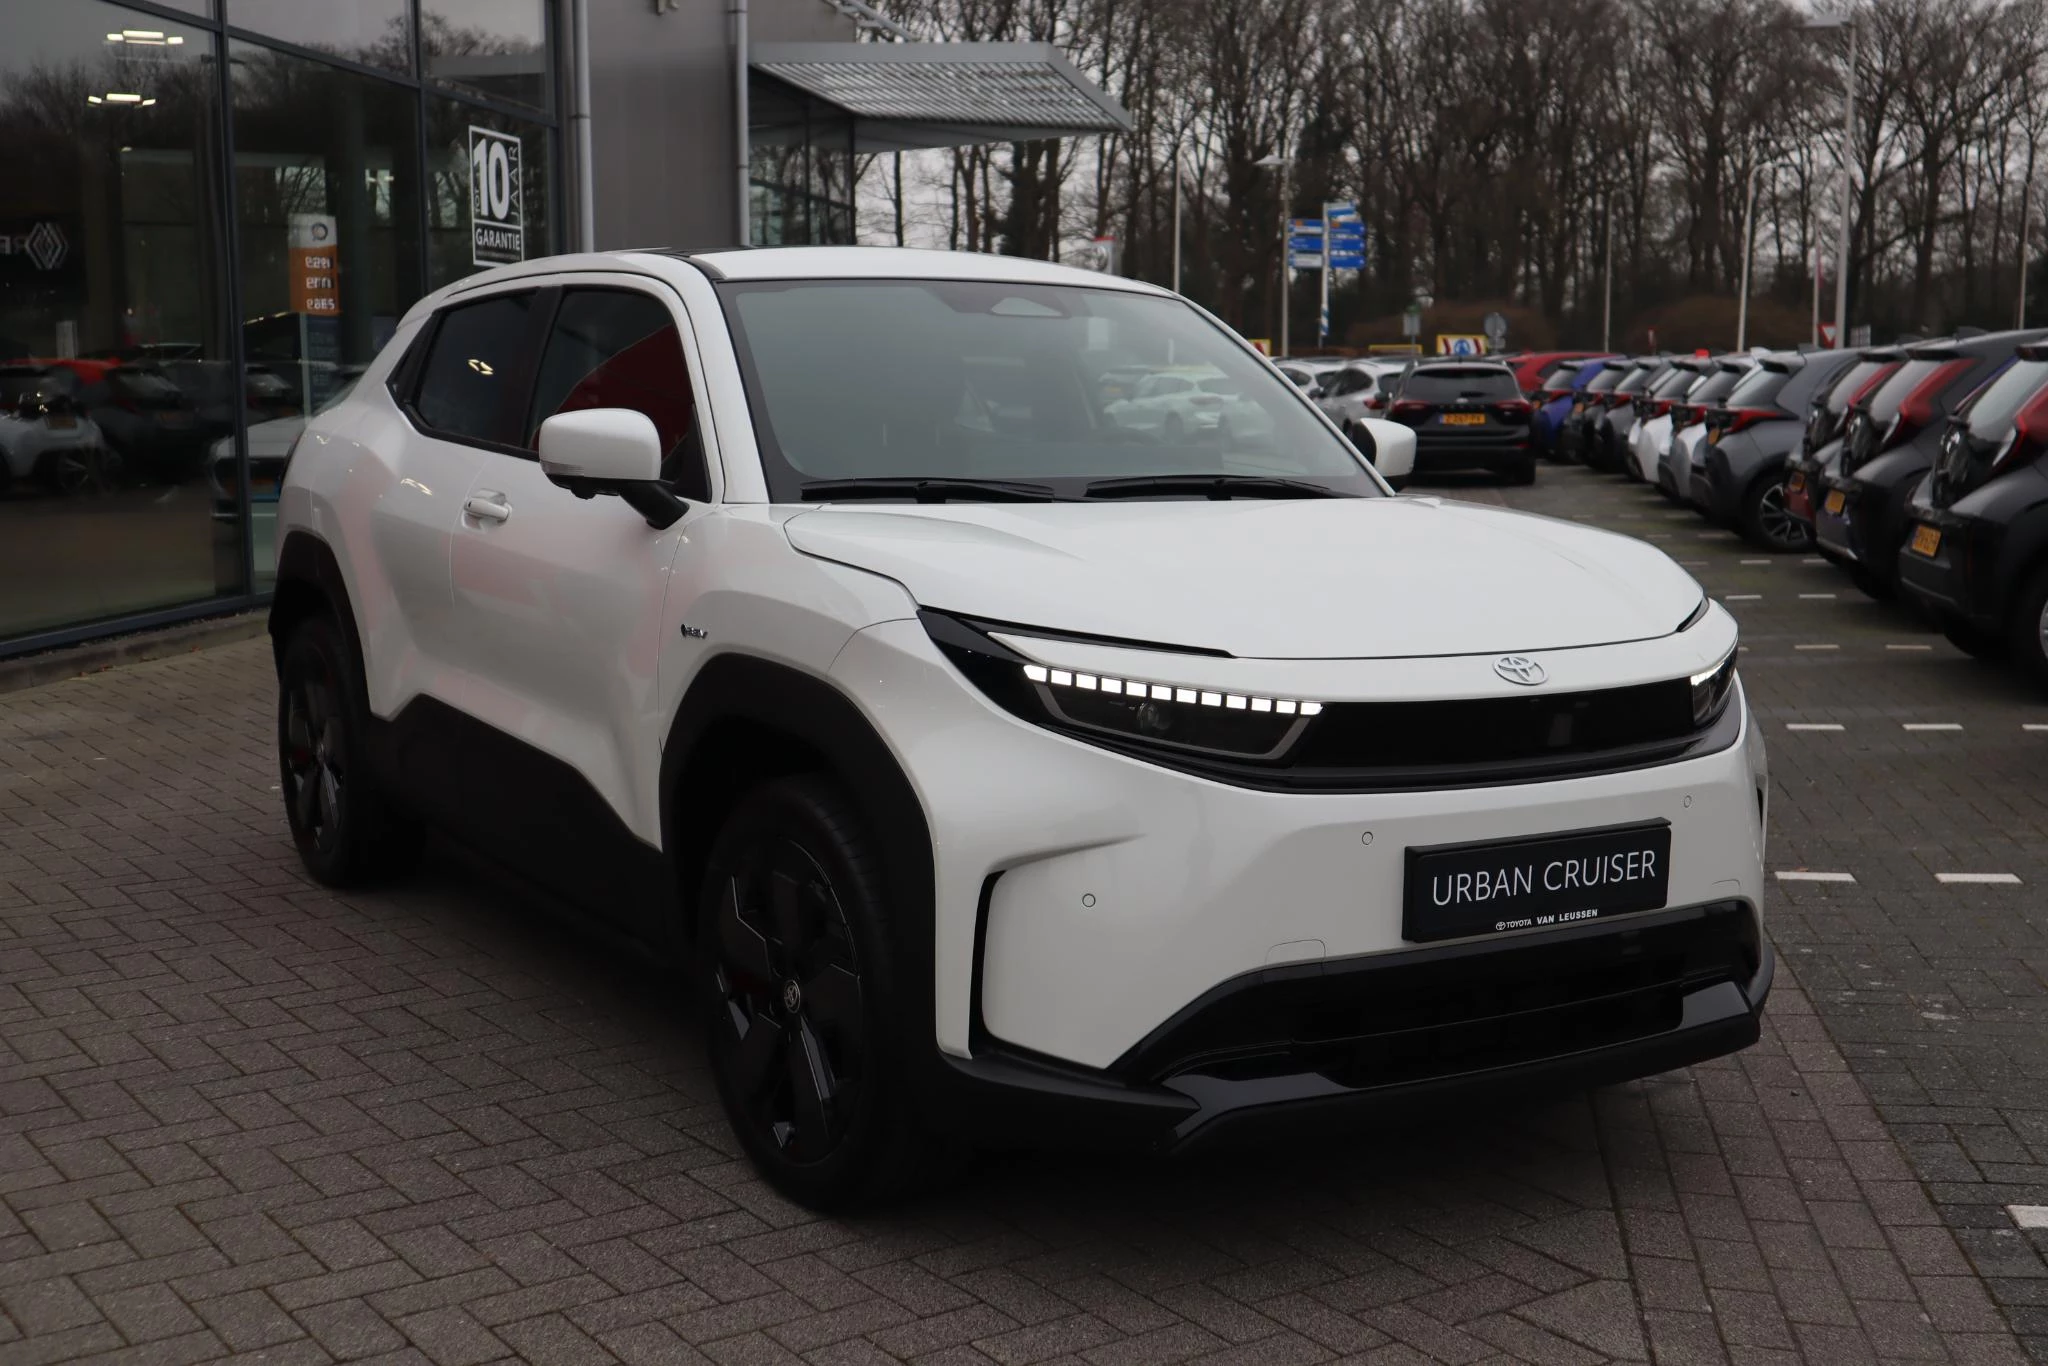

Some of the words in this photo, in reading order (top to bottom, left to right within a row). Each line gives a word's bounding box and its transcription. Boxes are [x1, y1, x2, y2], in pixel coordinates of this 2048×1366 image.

[473, 138, 509, 220] 10
[508, 146, 519, 221] JAAR
[476, 228, 521, 251] GARANTIE
[1432, 865, 1533, 906] URBAN
[1543, 849, 1656, 891] CRUISER
[1506, 918, 1532, 928] TOYOTA
[1536, 916, 1555, 925] VAN
[1558, 908, 1598, 922] LEUSSEN
